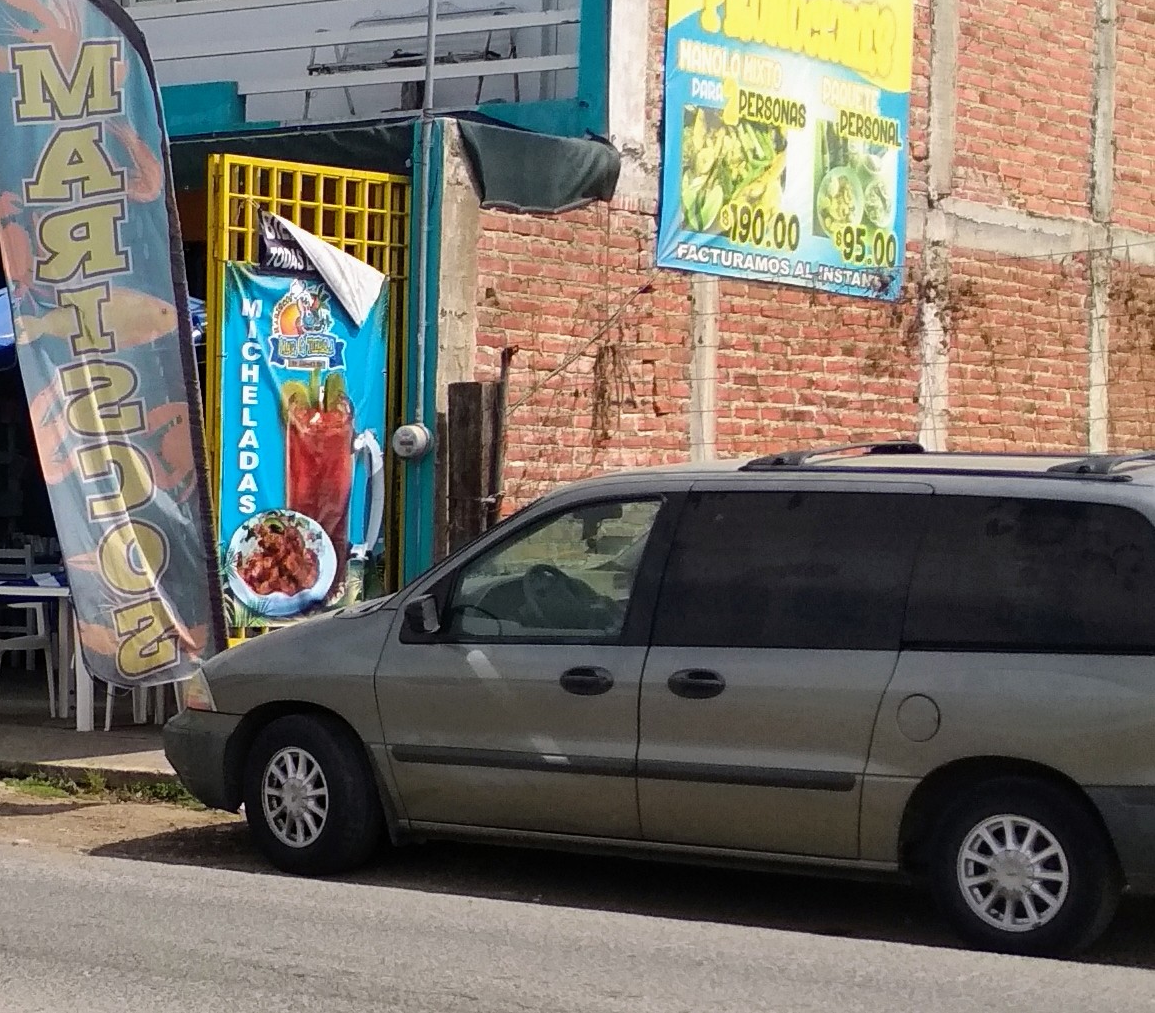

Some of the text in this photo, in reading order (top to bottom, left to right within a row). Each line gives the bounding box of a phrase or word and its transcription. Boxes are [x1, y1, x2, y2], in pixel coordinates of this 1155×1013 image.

[692, 78, 724, 101] PARA
[738, 90, 807, 128] PERSONAS
[839, 110, 902, 147] PERSONAL
[721, 203, 800, 251] $190.00
[836, 227, 896, 267] $95.00
[266, 246, 305, 271] TODAS
[676, 244, 790, 276] FACTURAMOS
[794, 262, 813, 279] AL
[237, 299, 263, 513] MICHELADAS
